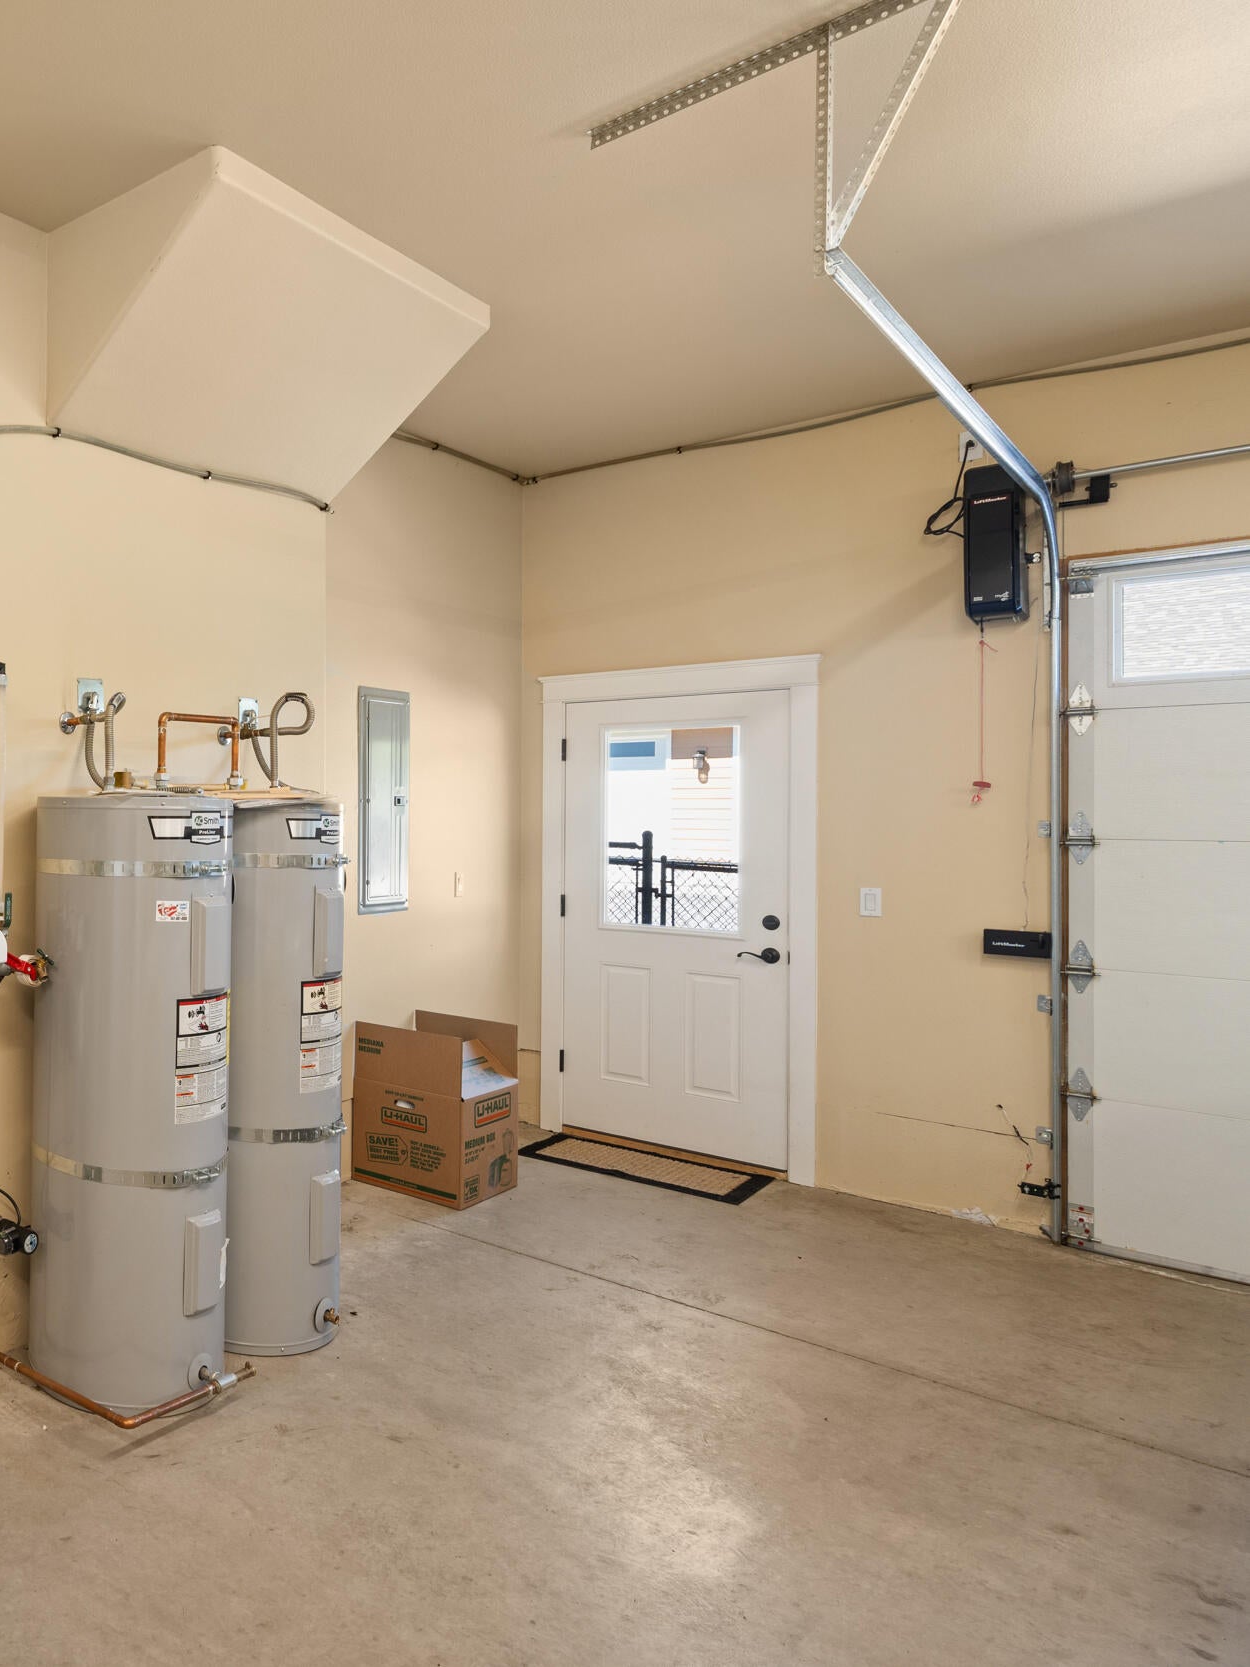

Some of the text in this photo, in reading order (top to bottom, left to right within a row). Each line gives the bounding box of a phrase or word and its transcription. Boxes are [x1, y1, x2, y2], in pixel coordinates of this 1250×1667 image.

[477, 1096, 509, 1118] U-HAUL
[384, 1110, 425, 1126] U-HAUL
[369, 1135, 399, 1147] SAVE!
